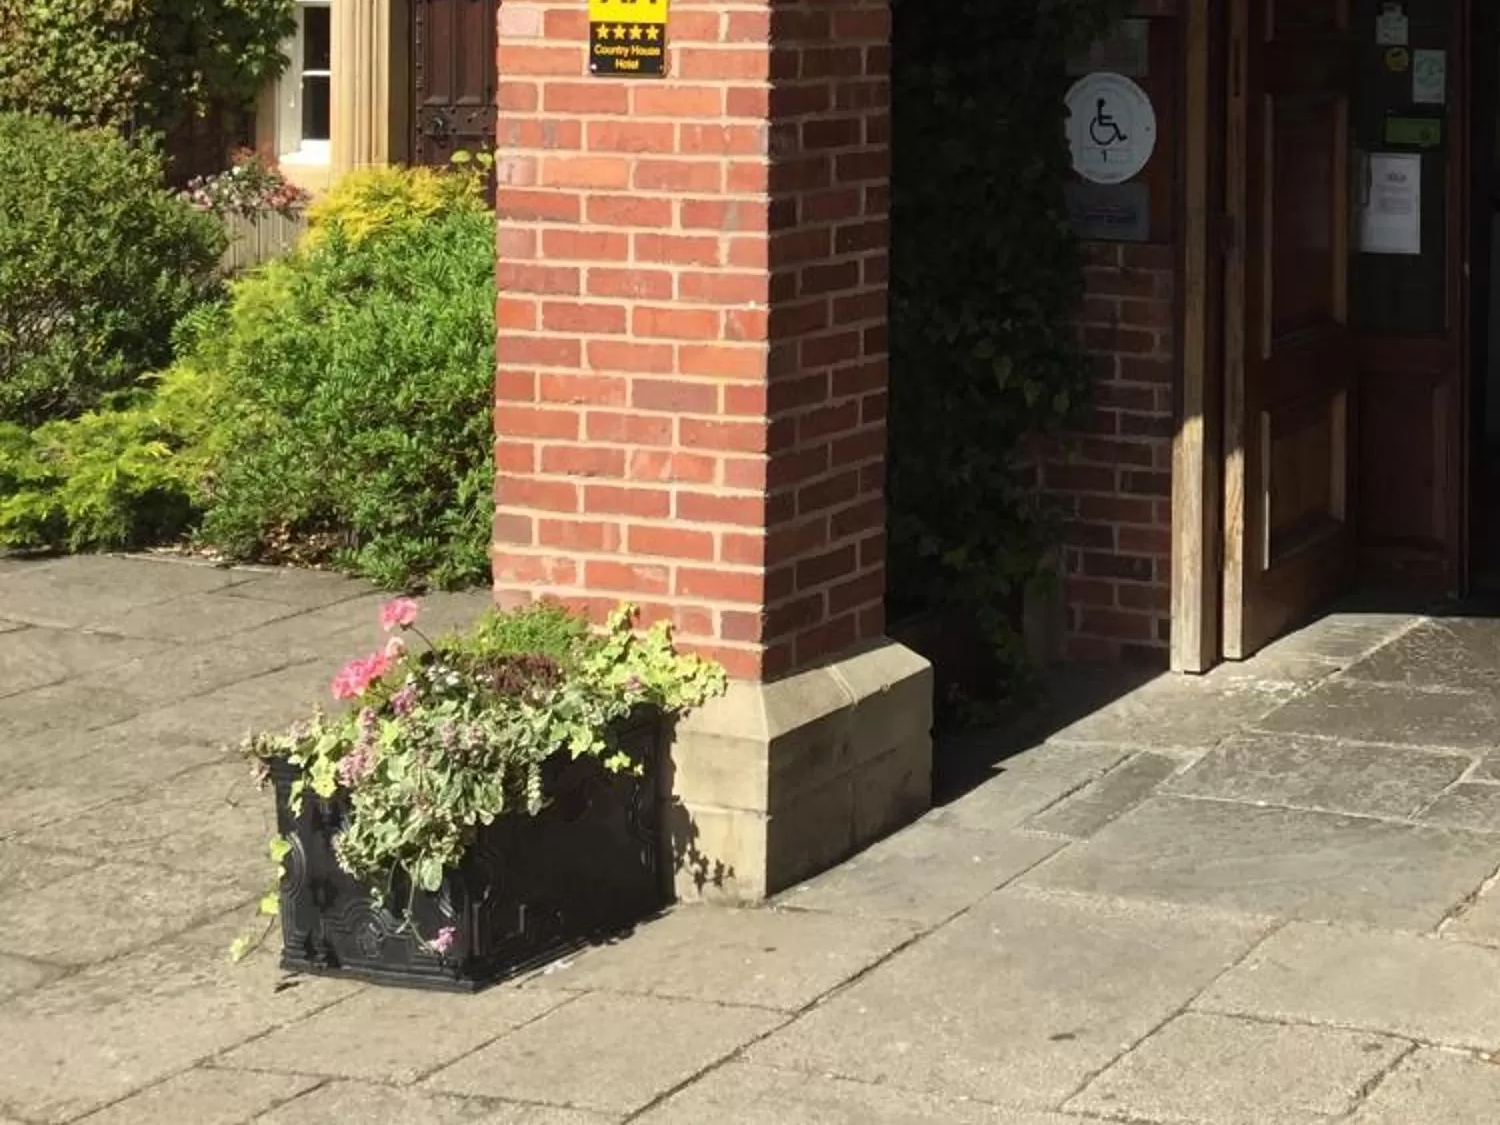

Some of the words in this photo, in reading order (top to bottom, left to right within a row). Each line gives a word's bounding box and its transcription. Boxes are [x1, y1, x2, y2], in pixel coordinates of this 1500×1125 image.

[594, 44, 629, 57] Country
[631, 44, 661, 56] House
[615, 58, 639, 70] Hotel
